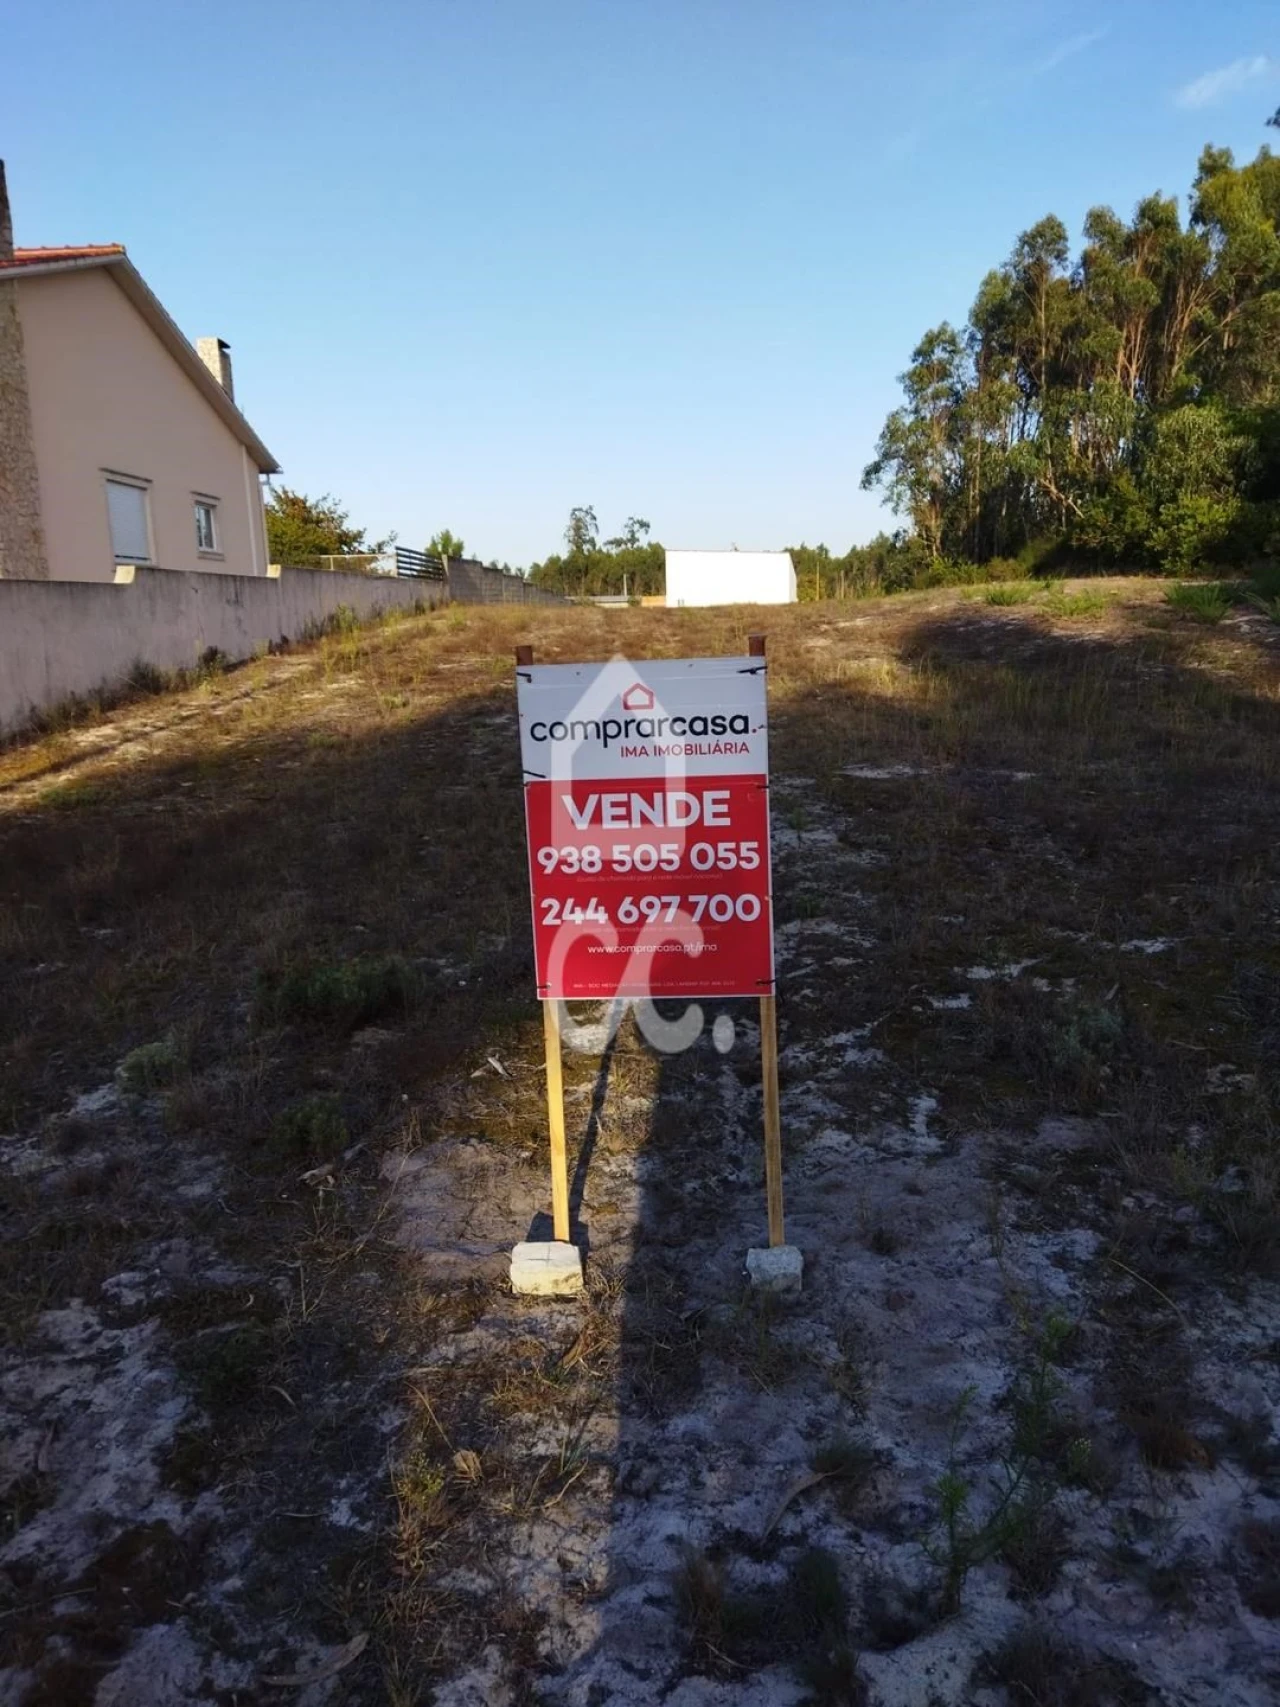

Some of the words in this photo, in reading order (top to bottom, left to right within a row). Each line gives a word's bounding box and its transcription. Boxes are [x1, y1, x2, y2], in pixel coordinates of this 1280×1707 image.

[620, 745, 649, 758] IMA
[653, 740, 750, 757] IMOBILIÁRIA
[561, 790, 731, 830] VENDE
[537, 845, 602, 874] 938
[611, 843, 680, 872] 505
[690, 841, 761, 871] 055
[540, 897, 608, 926] 244
[617, 895, 681, 924] 697
[688, 893, 761, 923] 700
